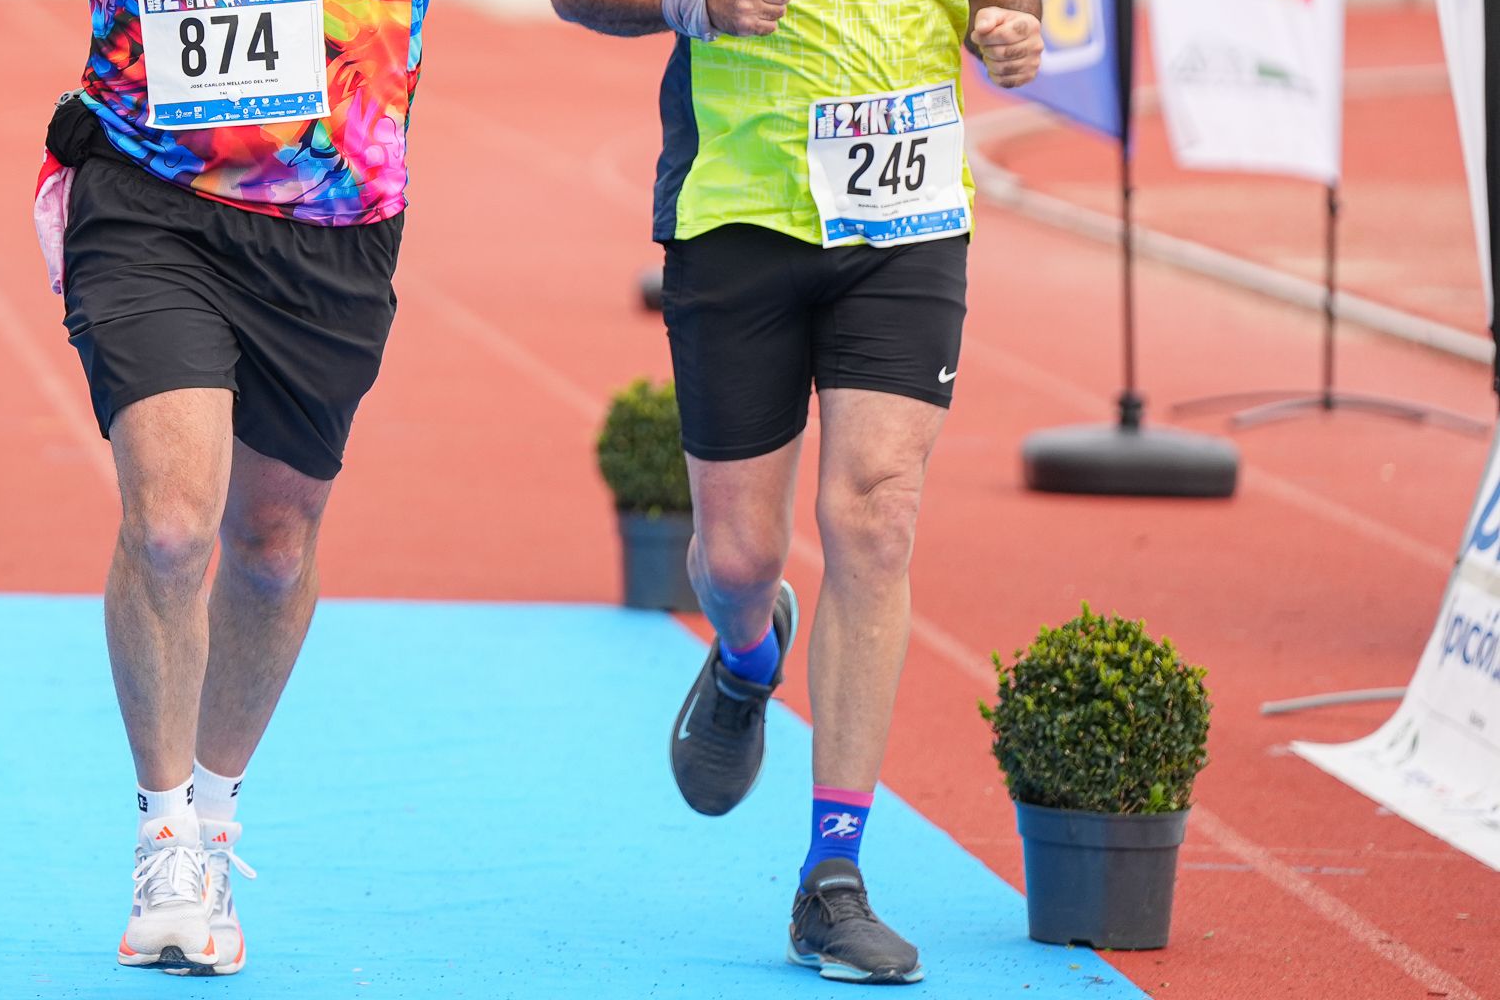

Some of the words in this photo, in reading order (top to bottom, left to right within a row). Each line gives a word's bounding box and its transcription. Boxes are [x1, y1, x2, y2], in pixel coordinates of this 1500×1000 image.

[179, 12, 279, 77] 874
[835, 99, 889, 137] 21K
[846, 137, 929, 197] 245
